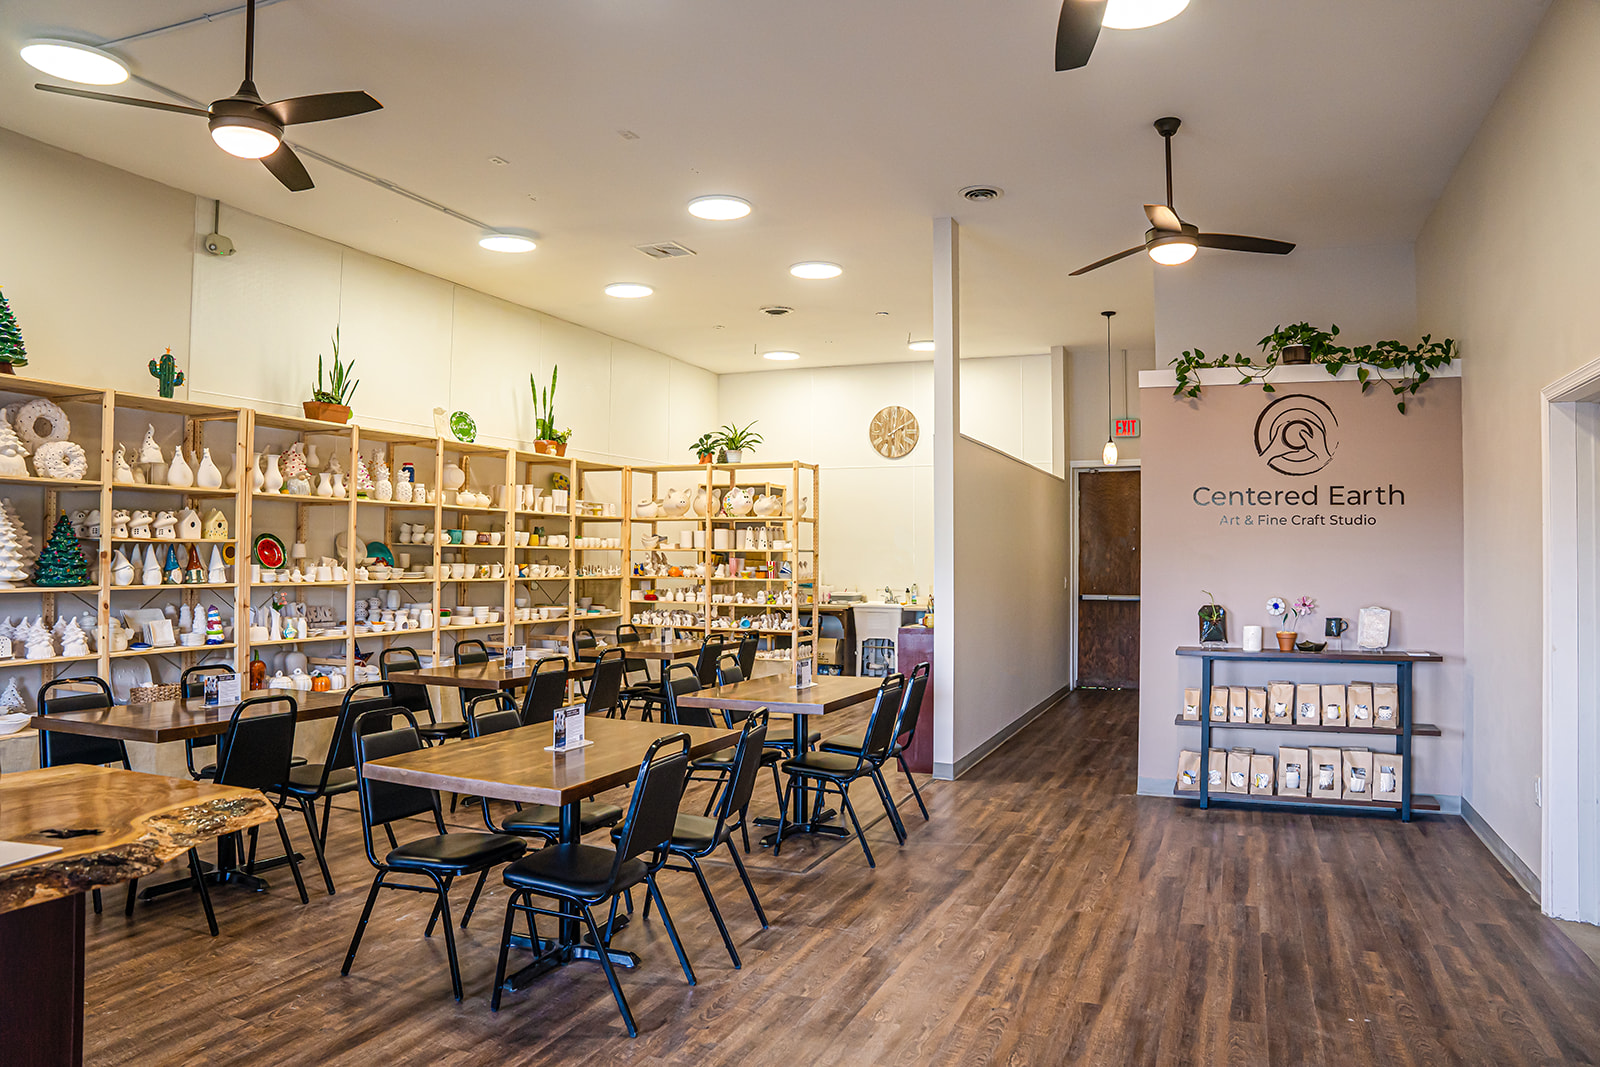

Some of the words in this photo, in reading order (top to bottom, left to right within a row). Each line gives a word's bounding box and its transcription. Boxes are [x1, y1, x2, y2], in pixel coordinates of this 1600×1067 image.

[1115, 419, 1137, 436] EXIT
[1193, 485, 1318, 506] Centered
[1330, 484, 1405, 506] Earth
[1220, 515, 1241, 526] Art
[1244, 515, 1254, 526] &
[1258, 514, 1288, 526] Fine
[1291, 514, 1326, 526] Craft
[1330, 514, 1377, 526] Studio
